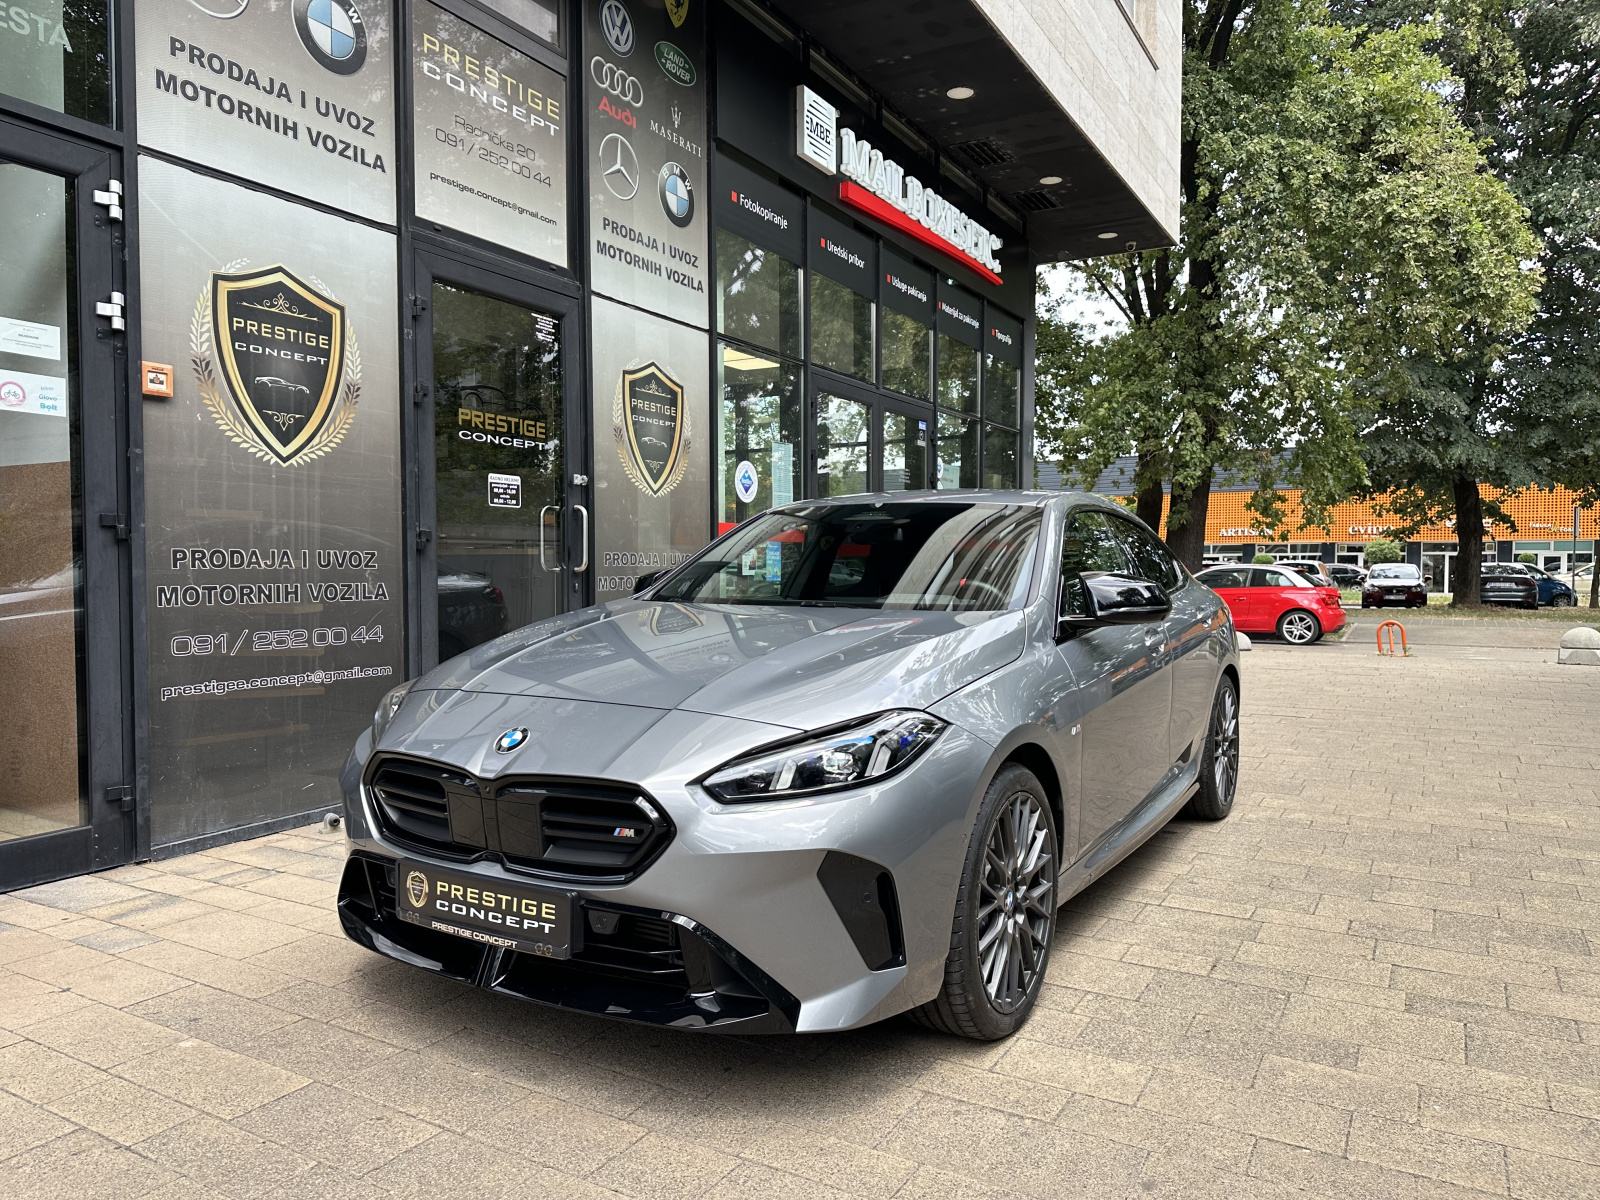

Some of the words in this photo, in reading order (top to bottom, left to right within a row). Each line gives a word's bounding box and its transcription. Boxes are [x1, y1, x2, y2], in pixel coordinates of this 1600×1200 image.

[664, 48, 684, 67] LAND
[665, 61, 690, 82] ROVER
[169, 36, 292, 103] PRODAJA
[300, 90, 307, 109] I
[315, 96, 375, 137] UVOZ
[423, 33, 559, 120] PRESTIGE
[423, 61, 559, 136] CONCEPT
[598, 96, 637, 129] Audi
[155, 68, 298, 140] MOTORNIH
[306, 126, 386, 173] VOZILA
[809, 117, 831, 145] MBE
[455, 115, 514, 152] Radnička
[516, 143, 536, 161] 20
[650, 120, 702, 158] MASERATI
[479, 147, 509, 169] 252
[512, 161, 530, 178] 00
[534, 172, 551, 188] 44
[662, 164, 691, 190] BMW
[840, 127, 907, 213] MAIL
[430, 172, 557, 226] prestigee.concept@gmail.com
[740, 194, 788, 229] Fotokopiranje
[603, 217, 658, 252] PRODAJA
[662, 242, 666, 255] I
[669, 244, 699, 268] UVOZ
[827, 240, 848, 260] Uredski
[848, 254, 865, 269] pribor
[596, 240, 662, 277] MOTORNIH
[665, 266, 704, 293] VOZILA
[232, 317, 329, 349] PRESTIGE
[234, 341, 328, 365] CONCEPT
[458, 408, 545, 439] PRESTIGE
[631, 399, 676, 416] PRESTIGE
[632, 415, 676, 428] CONCEPT
[458, 430, 546, 450] CONCEPT
[171, 548, 294, 570] PRODAJA
[301, 550, 309, 570] I
[317, 550, 378, 570] UVOZ
[604, 551, 660, 567] PRODAJA
[157, 583, 300, 607] MOTORNIH
[307, 582, 389, 602] VOZILA
[253, 629, 308, 650] 252
[313, 627, 346, 647] 00
[351, 625, 383, 643] 44
[161, 665, 392, 701] prestigee.concept@gmail.com
[436, 881, 556, 920] PRESTIGE
[436, 900, 556, 934] CONCEPT
[431, 921, 472, 938] PRESTIGE
[472, 931, 518, 949] CONCEPT
